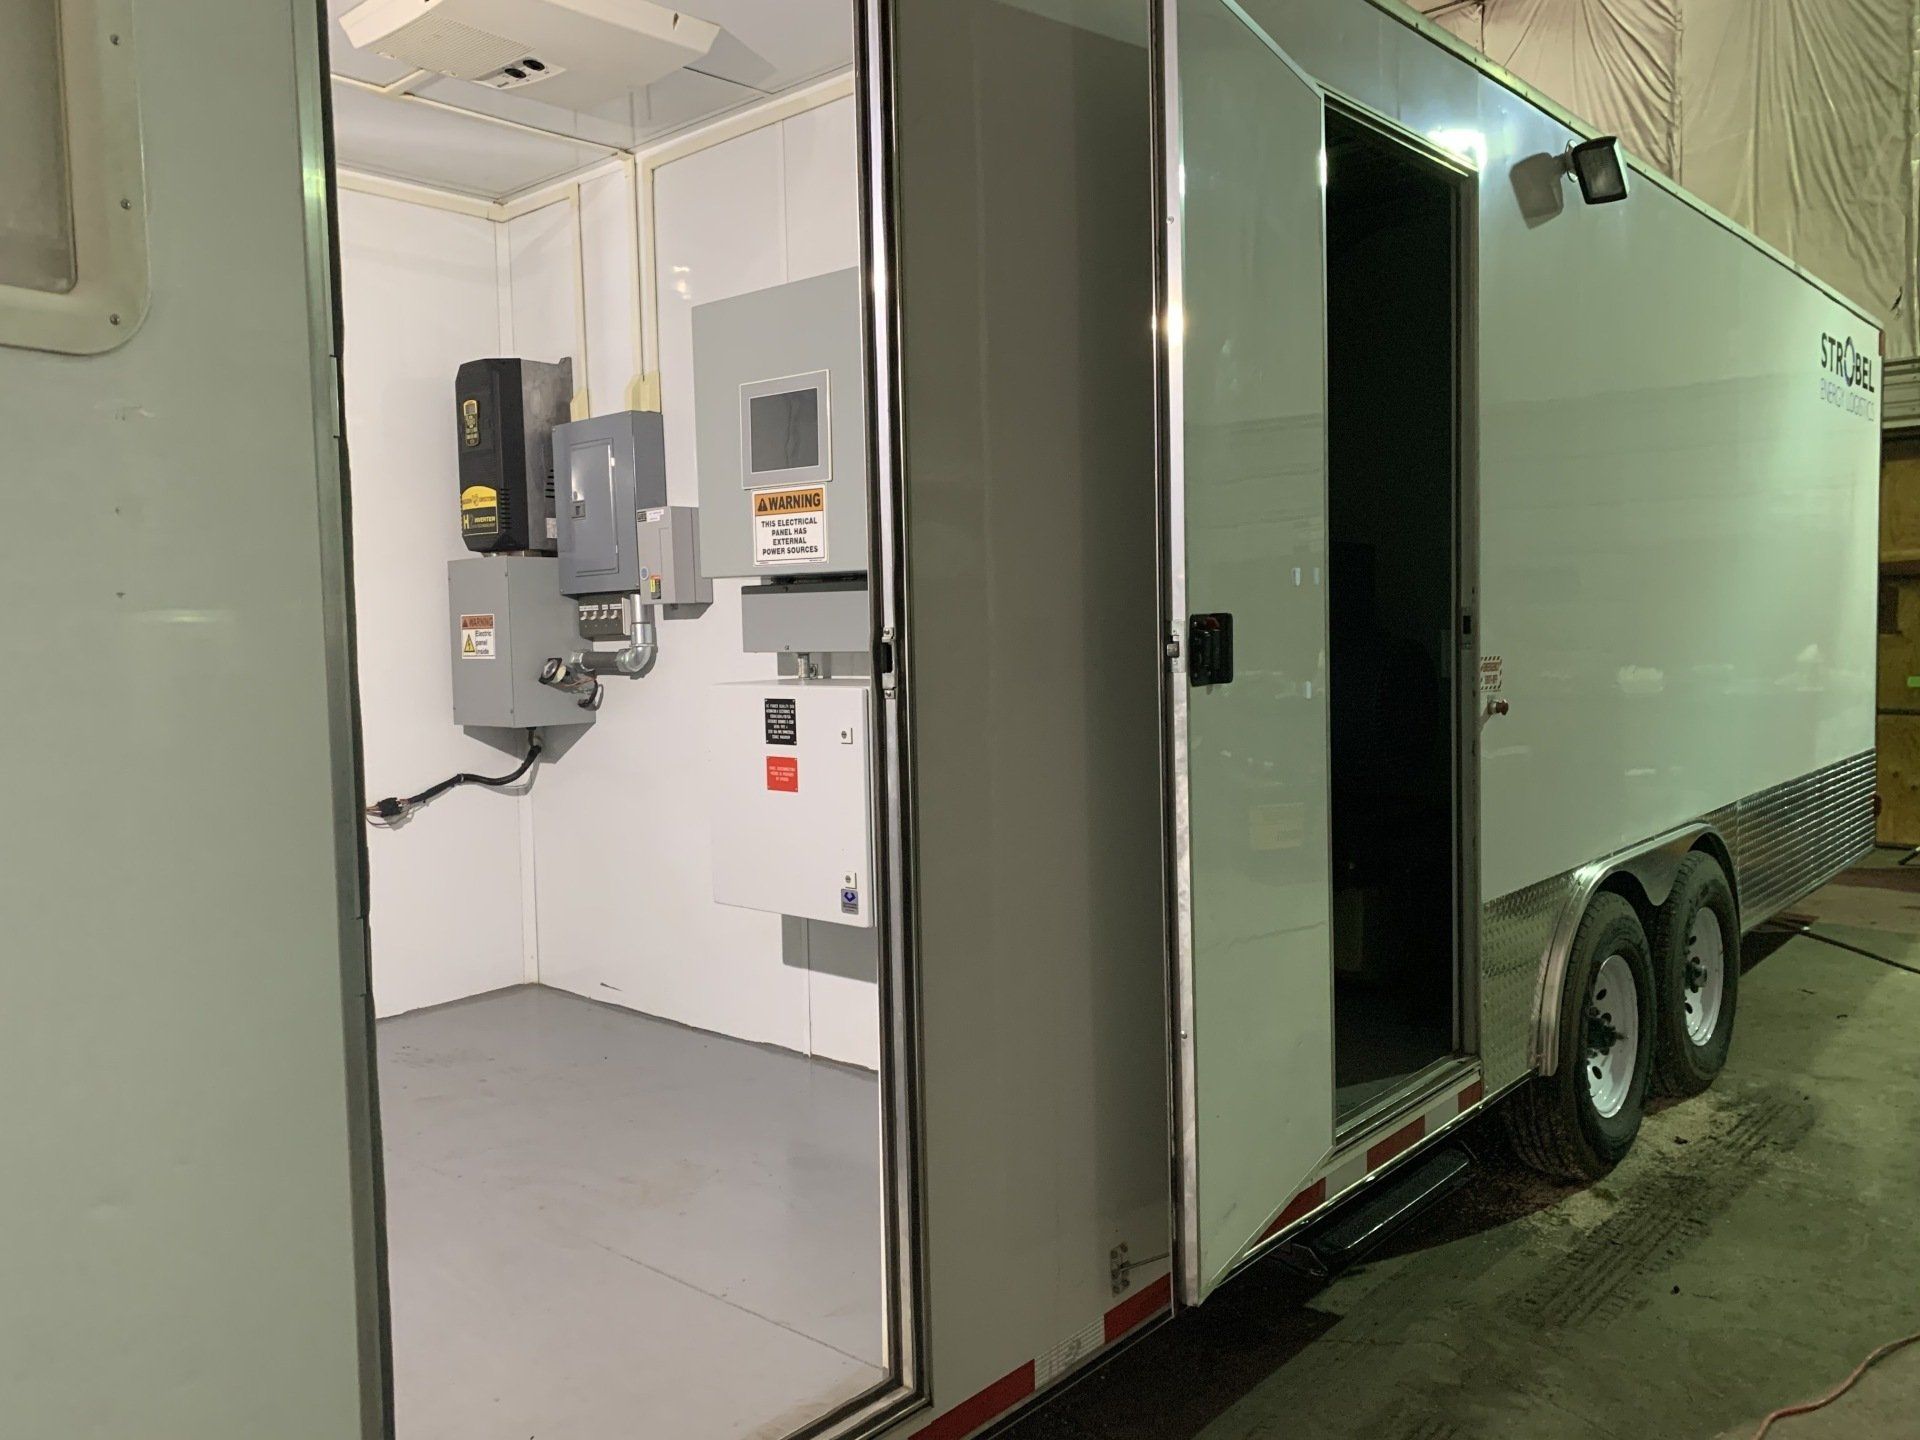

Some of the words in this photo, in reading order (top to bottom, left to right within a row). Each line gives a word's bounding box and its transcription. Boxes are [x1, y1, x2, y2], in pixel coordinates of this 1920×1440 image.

[1821, 332, 1875, 393] STROBEL
[768, 493, 821, 511] WARNING
[761, 520, 776, 528] THIS
[777, 517, 818, 527] ELECTRICAL
[771, 528, 792, 536] PANEL
[793, 527, 807, 535] HAS
[772, 537, 807, 546] EXTERNAL
[762, 548, 785, 556] POWER
[786, 545, 818, 554] SOURCES
[469, 616, 494, 627] WARNING
